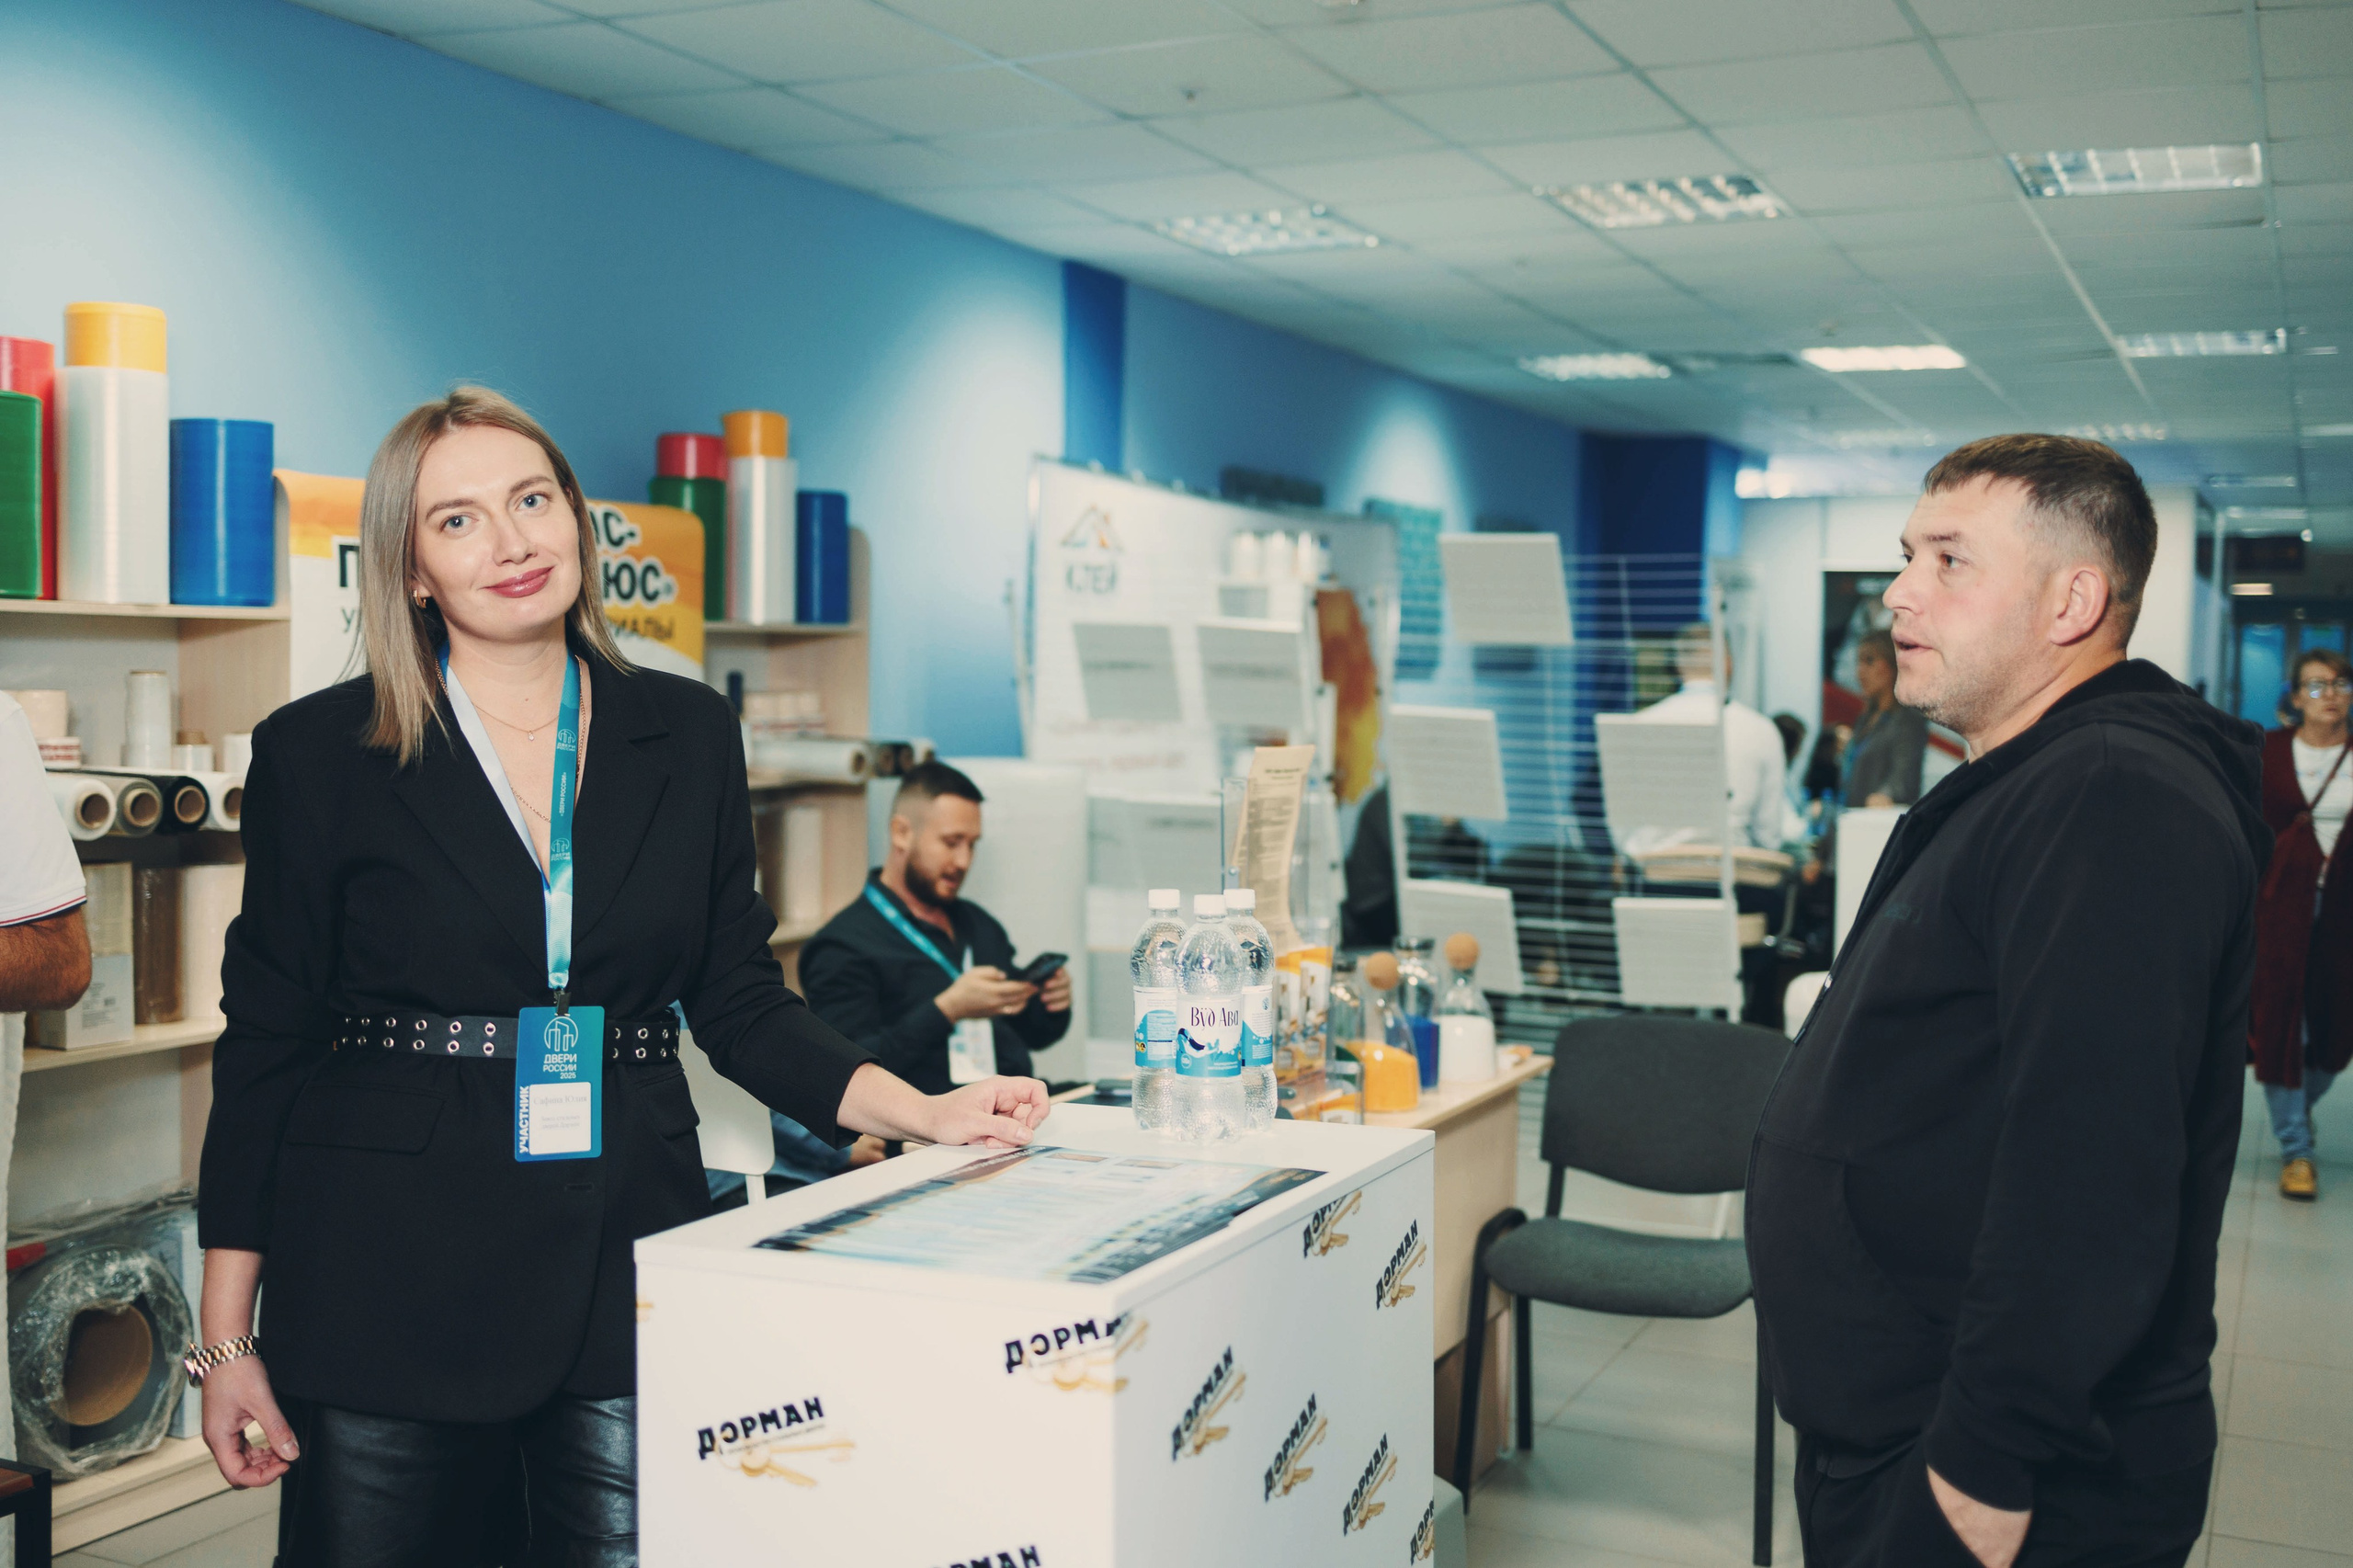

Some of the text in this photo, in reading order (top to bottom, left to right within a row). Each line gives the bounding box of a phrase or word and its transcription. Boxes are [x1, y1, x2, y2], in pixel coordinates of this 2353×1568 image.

[542, 1063, 577, 1073] РОССИИ
[543, 1053, 577, 1064] ДВЕРИ
[560, 1072, 576, 1080] 2025
[518, 1085, 530, 1154] УЧАСТНИК
[1375, 1219, 1418, 1312] ДОРМАН
[697, 1396, 825, 1461] ДОРМАН
[1171, 1346, 1234, 1461] ДОРМАН
[1264, 1392, 1317, 1503] ДОРМАН
[1342, 1431, 1389, 1538] ДОРМАН
